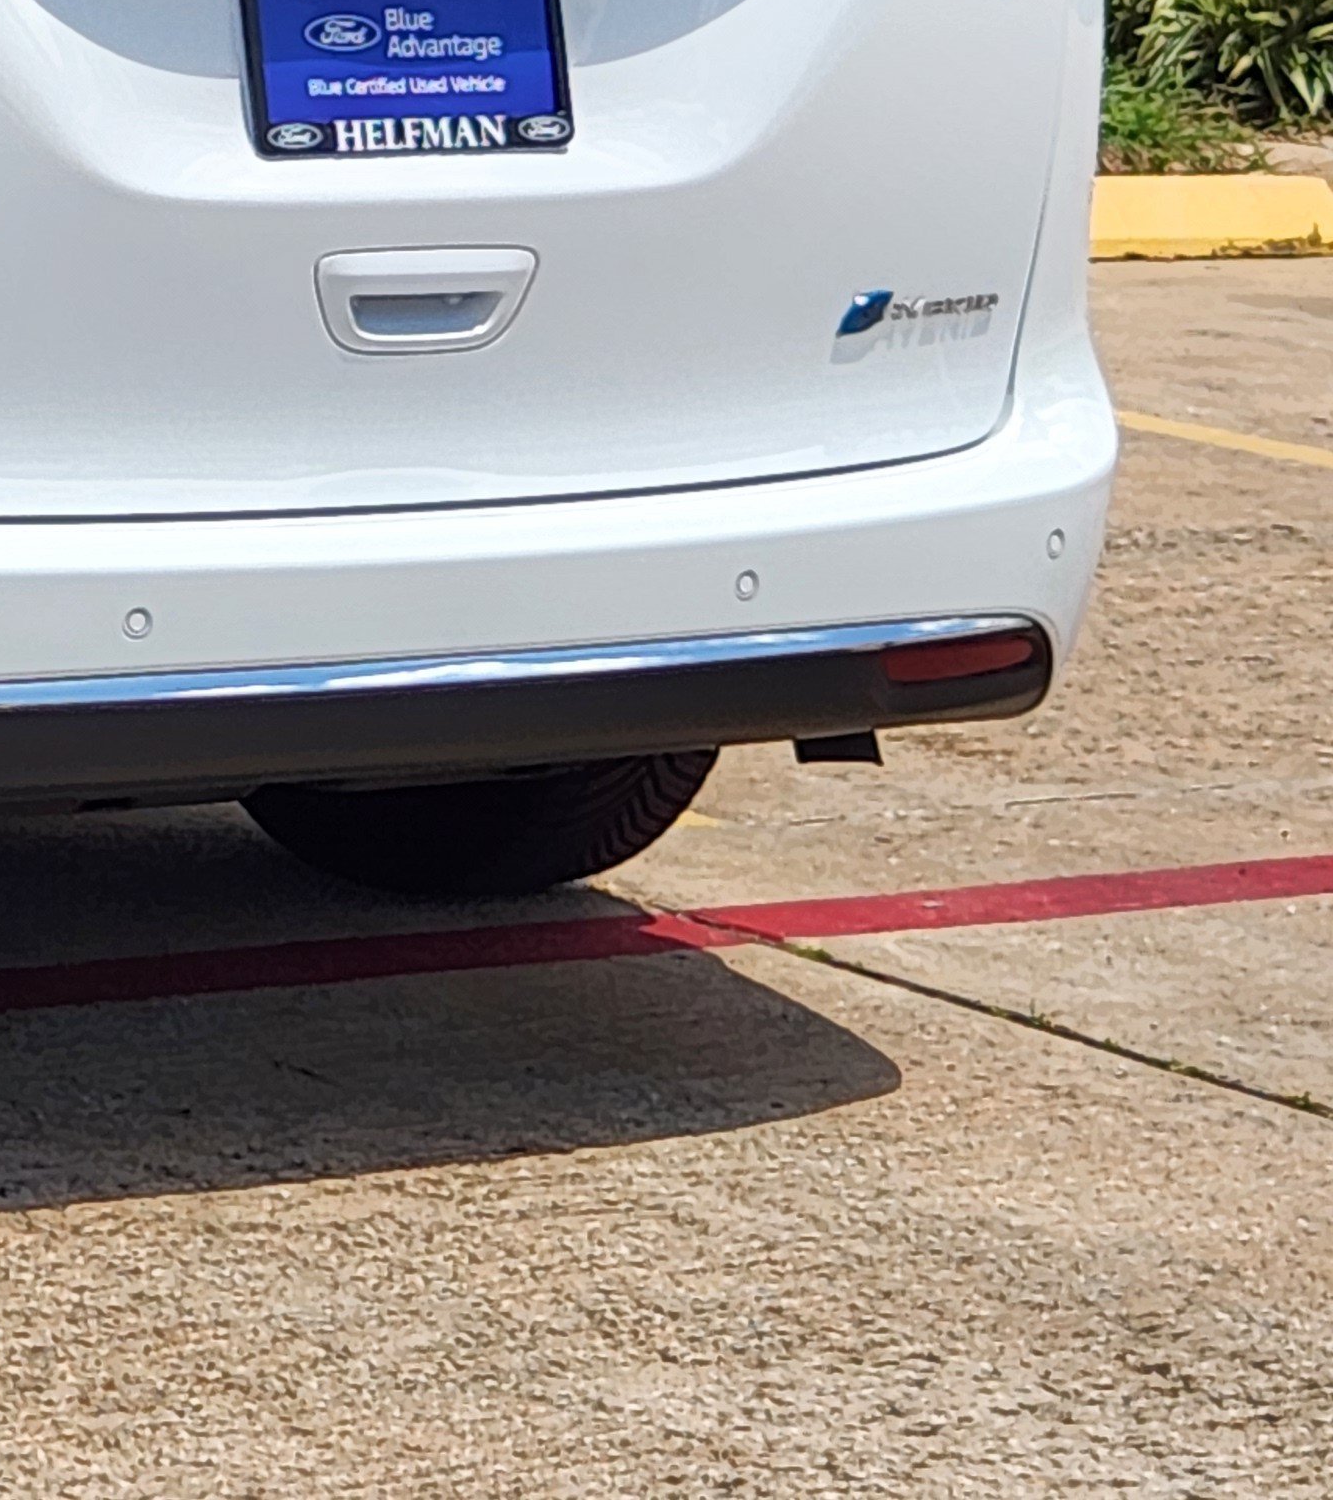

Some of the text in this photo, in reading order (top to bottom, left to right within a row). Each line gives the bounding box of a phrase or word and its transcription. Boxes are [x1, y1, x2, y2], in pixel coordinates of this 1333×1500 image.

[385, 8, 434, 30] Blue
[319, 20, 367, 44] Ford
[388, 36, 503, 60] Advantage
[307, 76, 506, 96] Blue Certified Used Vehicle
[336, 115, 507, 151] HELFMAN
